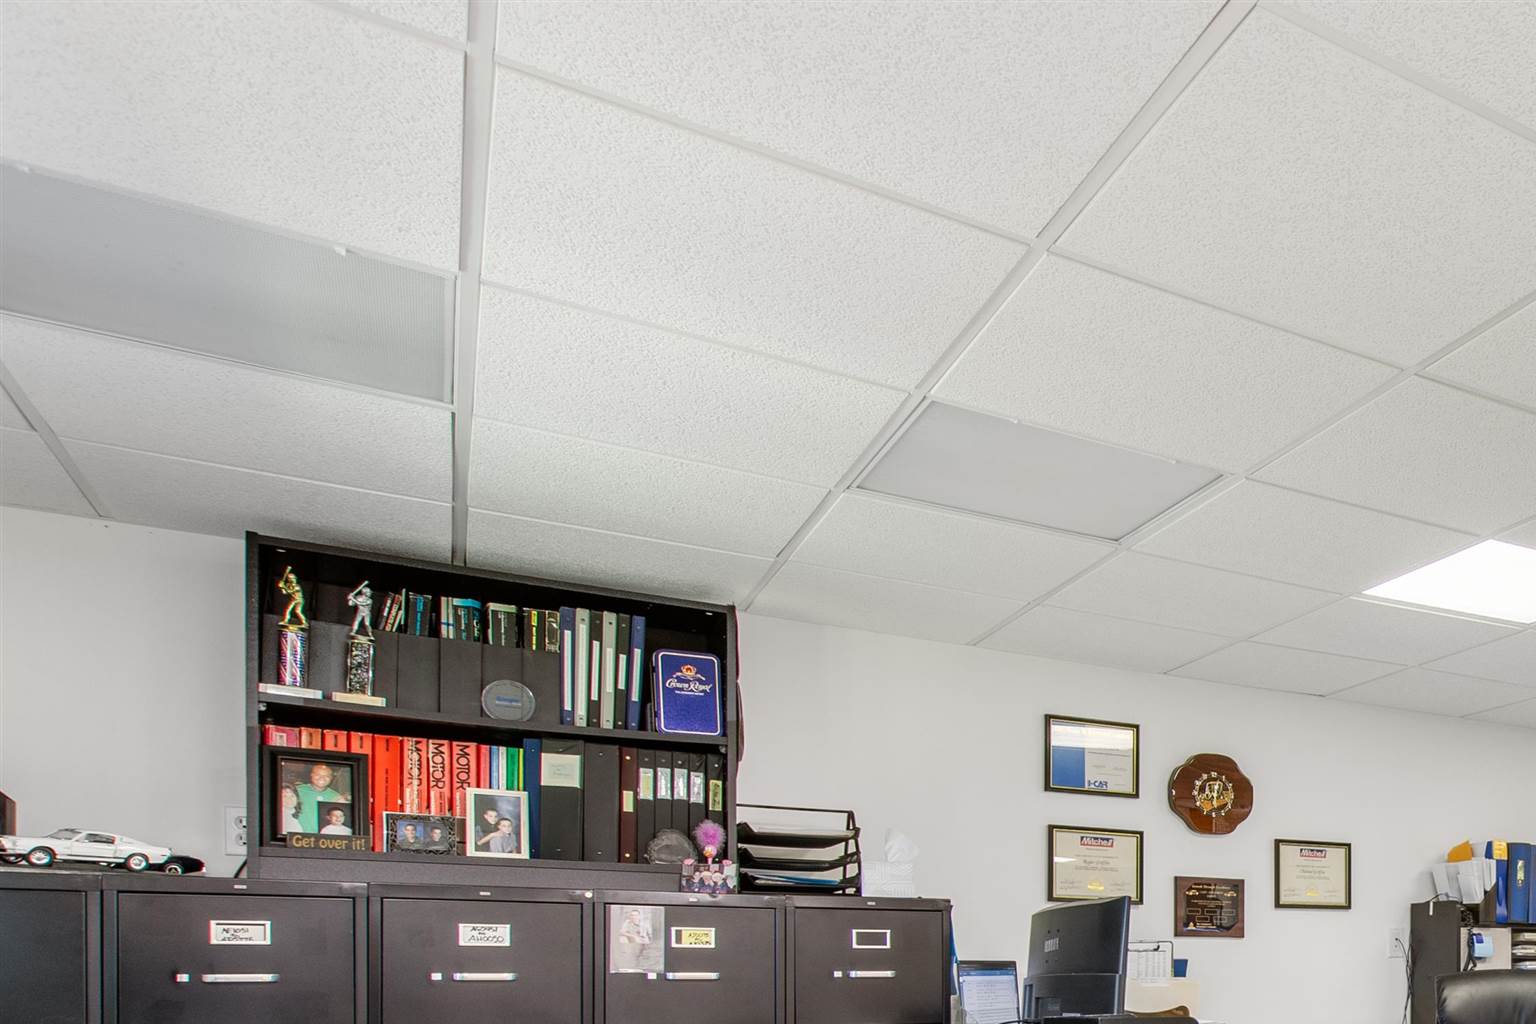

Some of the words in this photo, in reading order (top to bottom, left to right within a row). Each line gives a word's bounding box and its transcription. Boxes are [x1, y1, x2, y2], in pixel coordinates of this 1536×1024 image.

[431, 742, 445, 790] MOTOR
[455, 744, 471, 791] MOTOR
[292, 835, 316, 849] Get
[319, 838, 348, 850] over
[352, 838, 366, 851] it!
